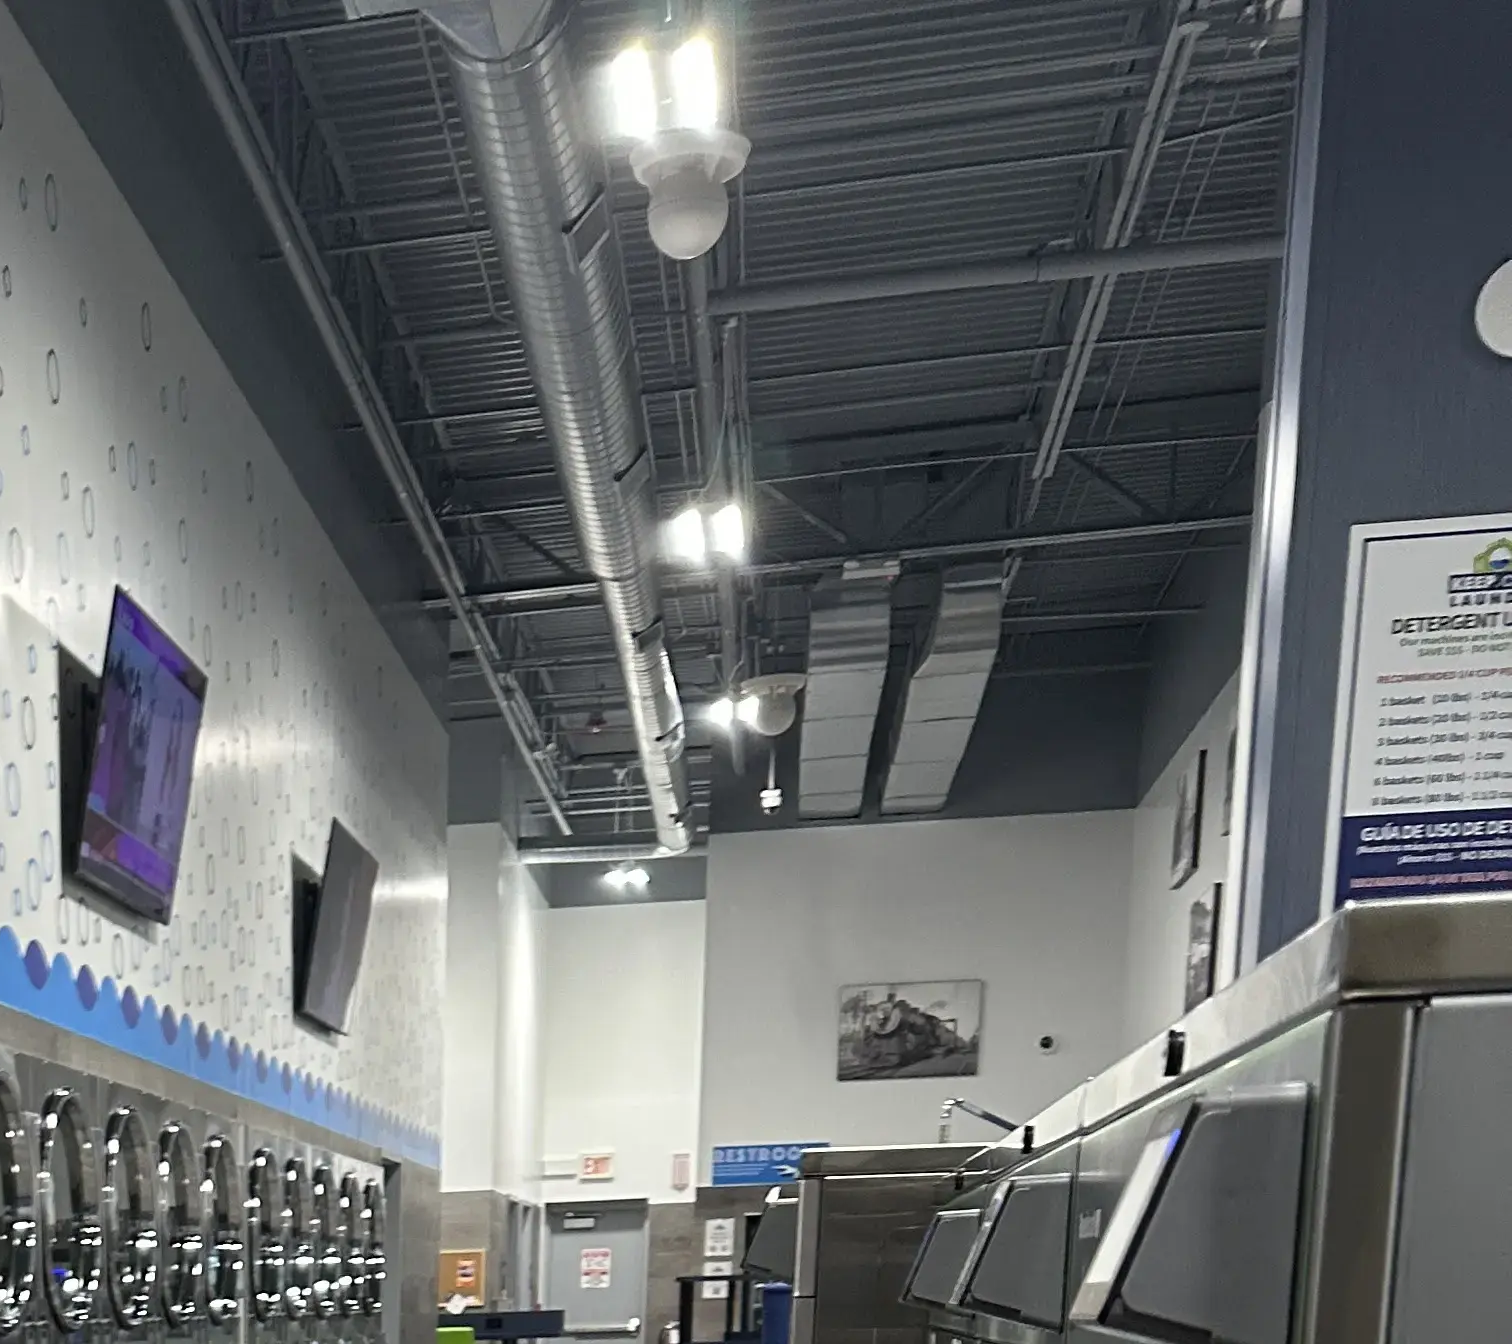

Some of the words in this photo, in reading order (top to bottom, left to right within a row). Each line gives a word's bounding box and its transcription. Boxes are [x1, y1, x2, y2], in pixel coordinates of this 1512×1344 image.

[1391, 612, 1501, 634] DETERGENT
[1360, 822, 1400, 842] GUÍA
[1402, 824, 1425, 839] DE
[1426, 822, 1460, 838] USO
[1462, 821, 1486, 836] DE
